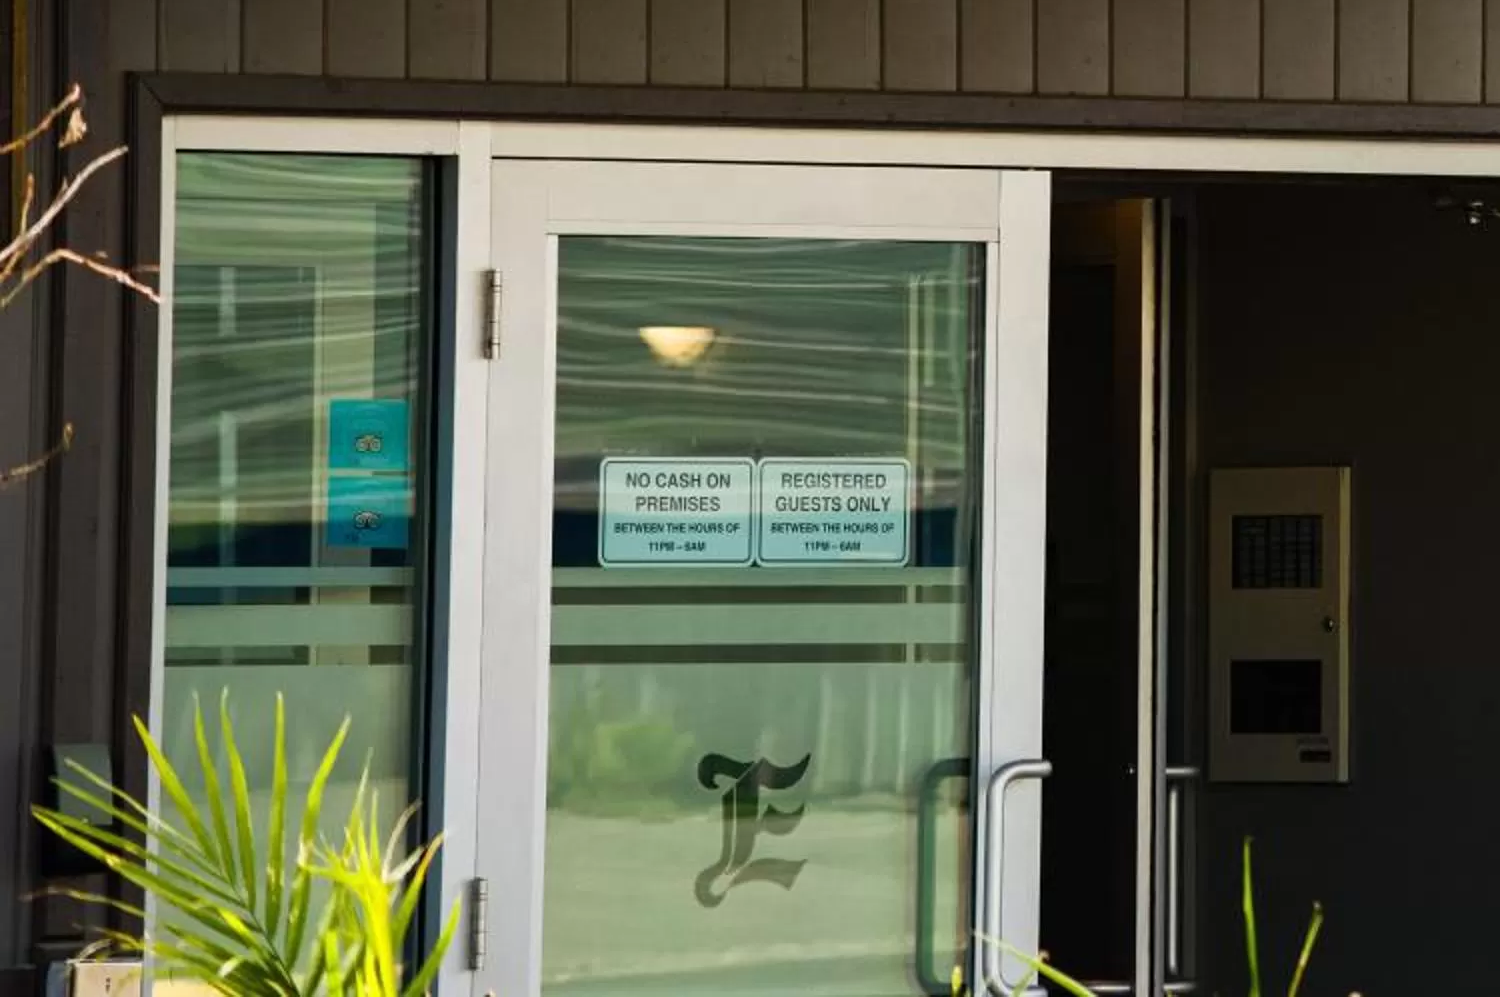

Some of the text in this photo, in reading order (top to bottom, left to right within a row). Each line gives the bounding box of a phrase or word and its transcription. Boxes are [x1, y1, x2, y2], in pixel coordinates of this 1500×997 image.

[625, 472, 731, 489] NO CASH ON
[781, 472, 887, 489] REGISTERED
[635, 496, 721, 512] PREMISES
[775, 496, 891, 512] GUESTS ONLY
[614, 522, 741, 534] BETWEEN THE HOURS OF
[770, 522, 895, 534] BETWEEN THE HOURS OF
